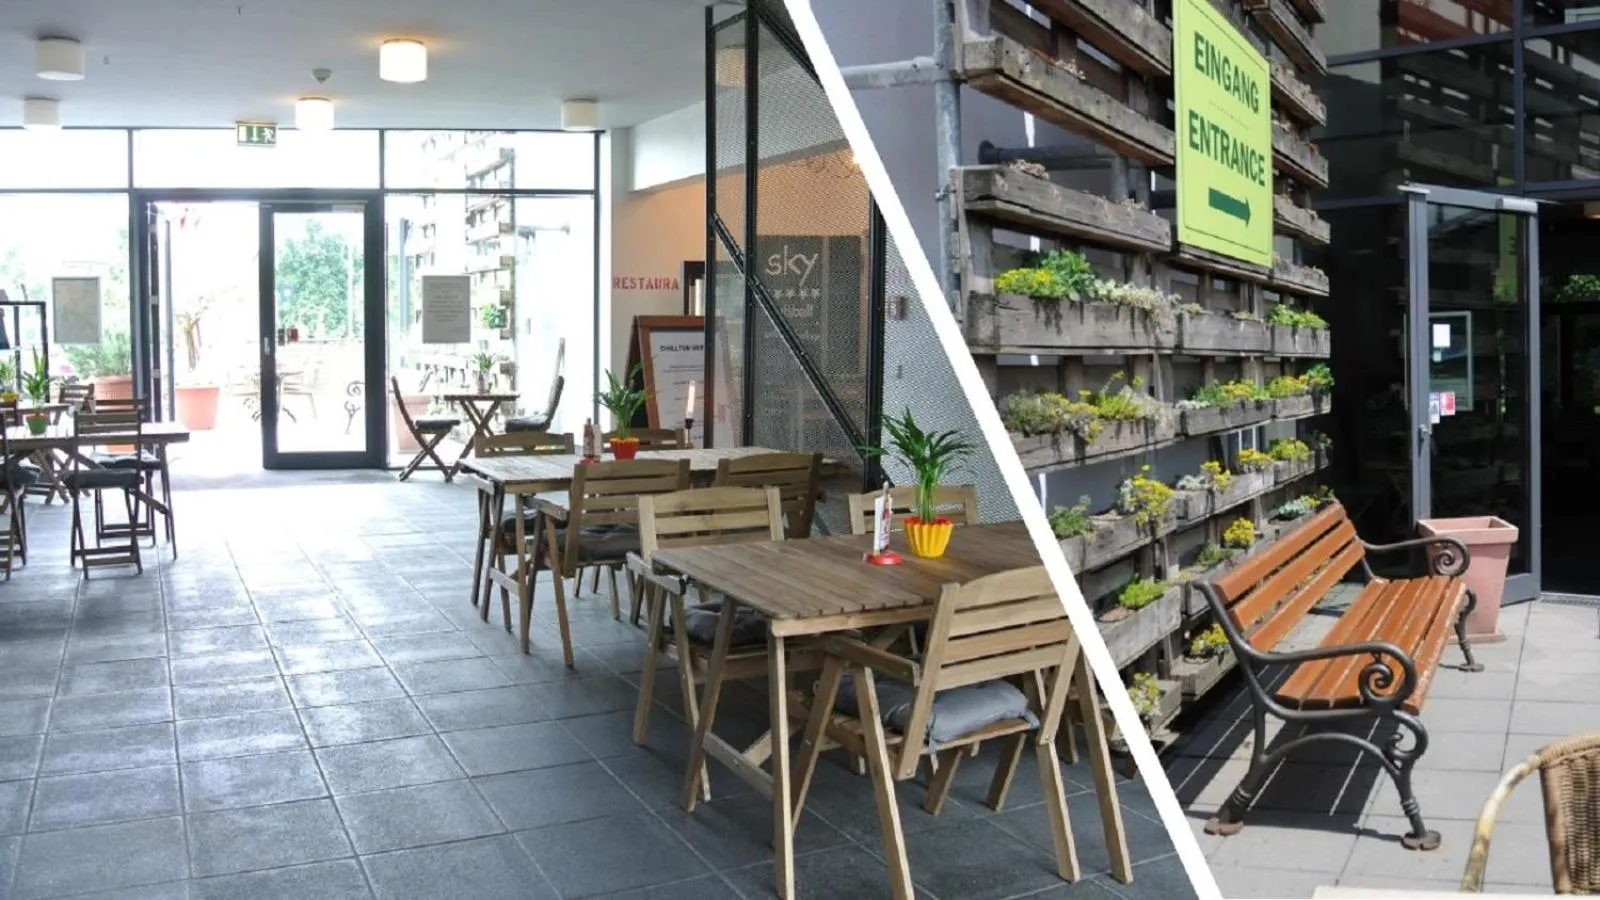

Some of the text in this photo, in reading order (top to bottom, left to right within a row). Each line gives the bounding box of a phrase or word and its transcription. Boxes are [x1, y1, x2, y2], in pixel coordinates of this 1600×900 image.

[1195, 31, 1260, 113] EINGANG
[1188, 109, 1266, 187] ENTRANCE
[765, 244, 818, 287] sky
